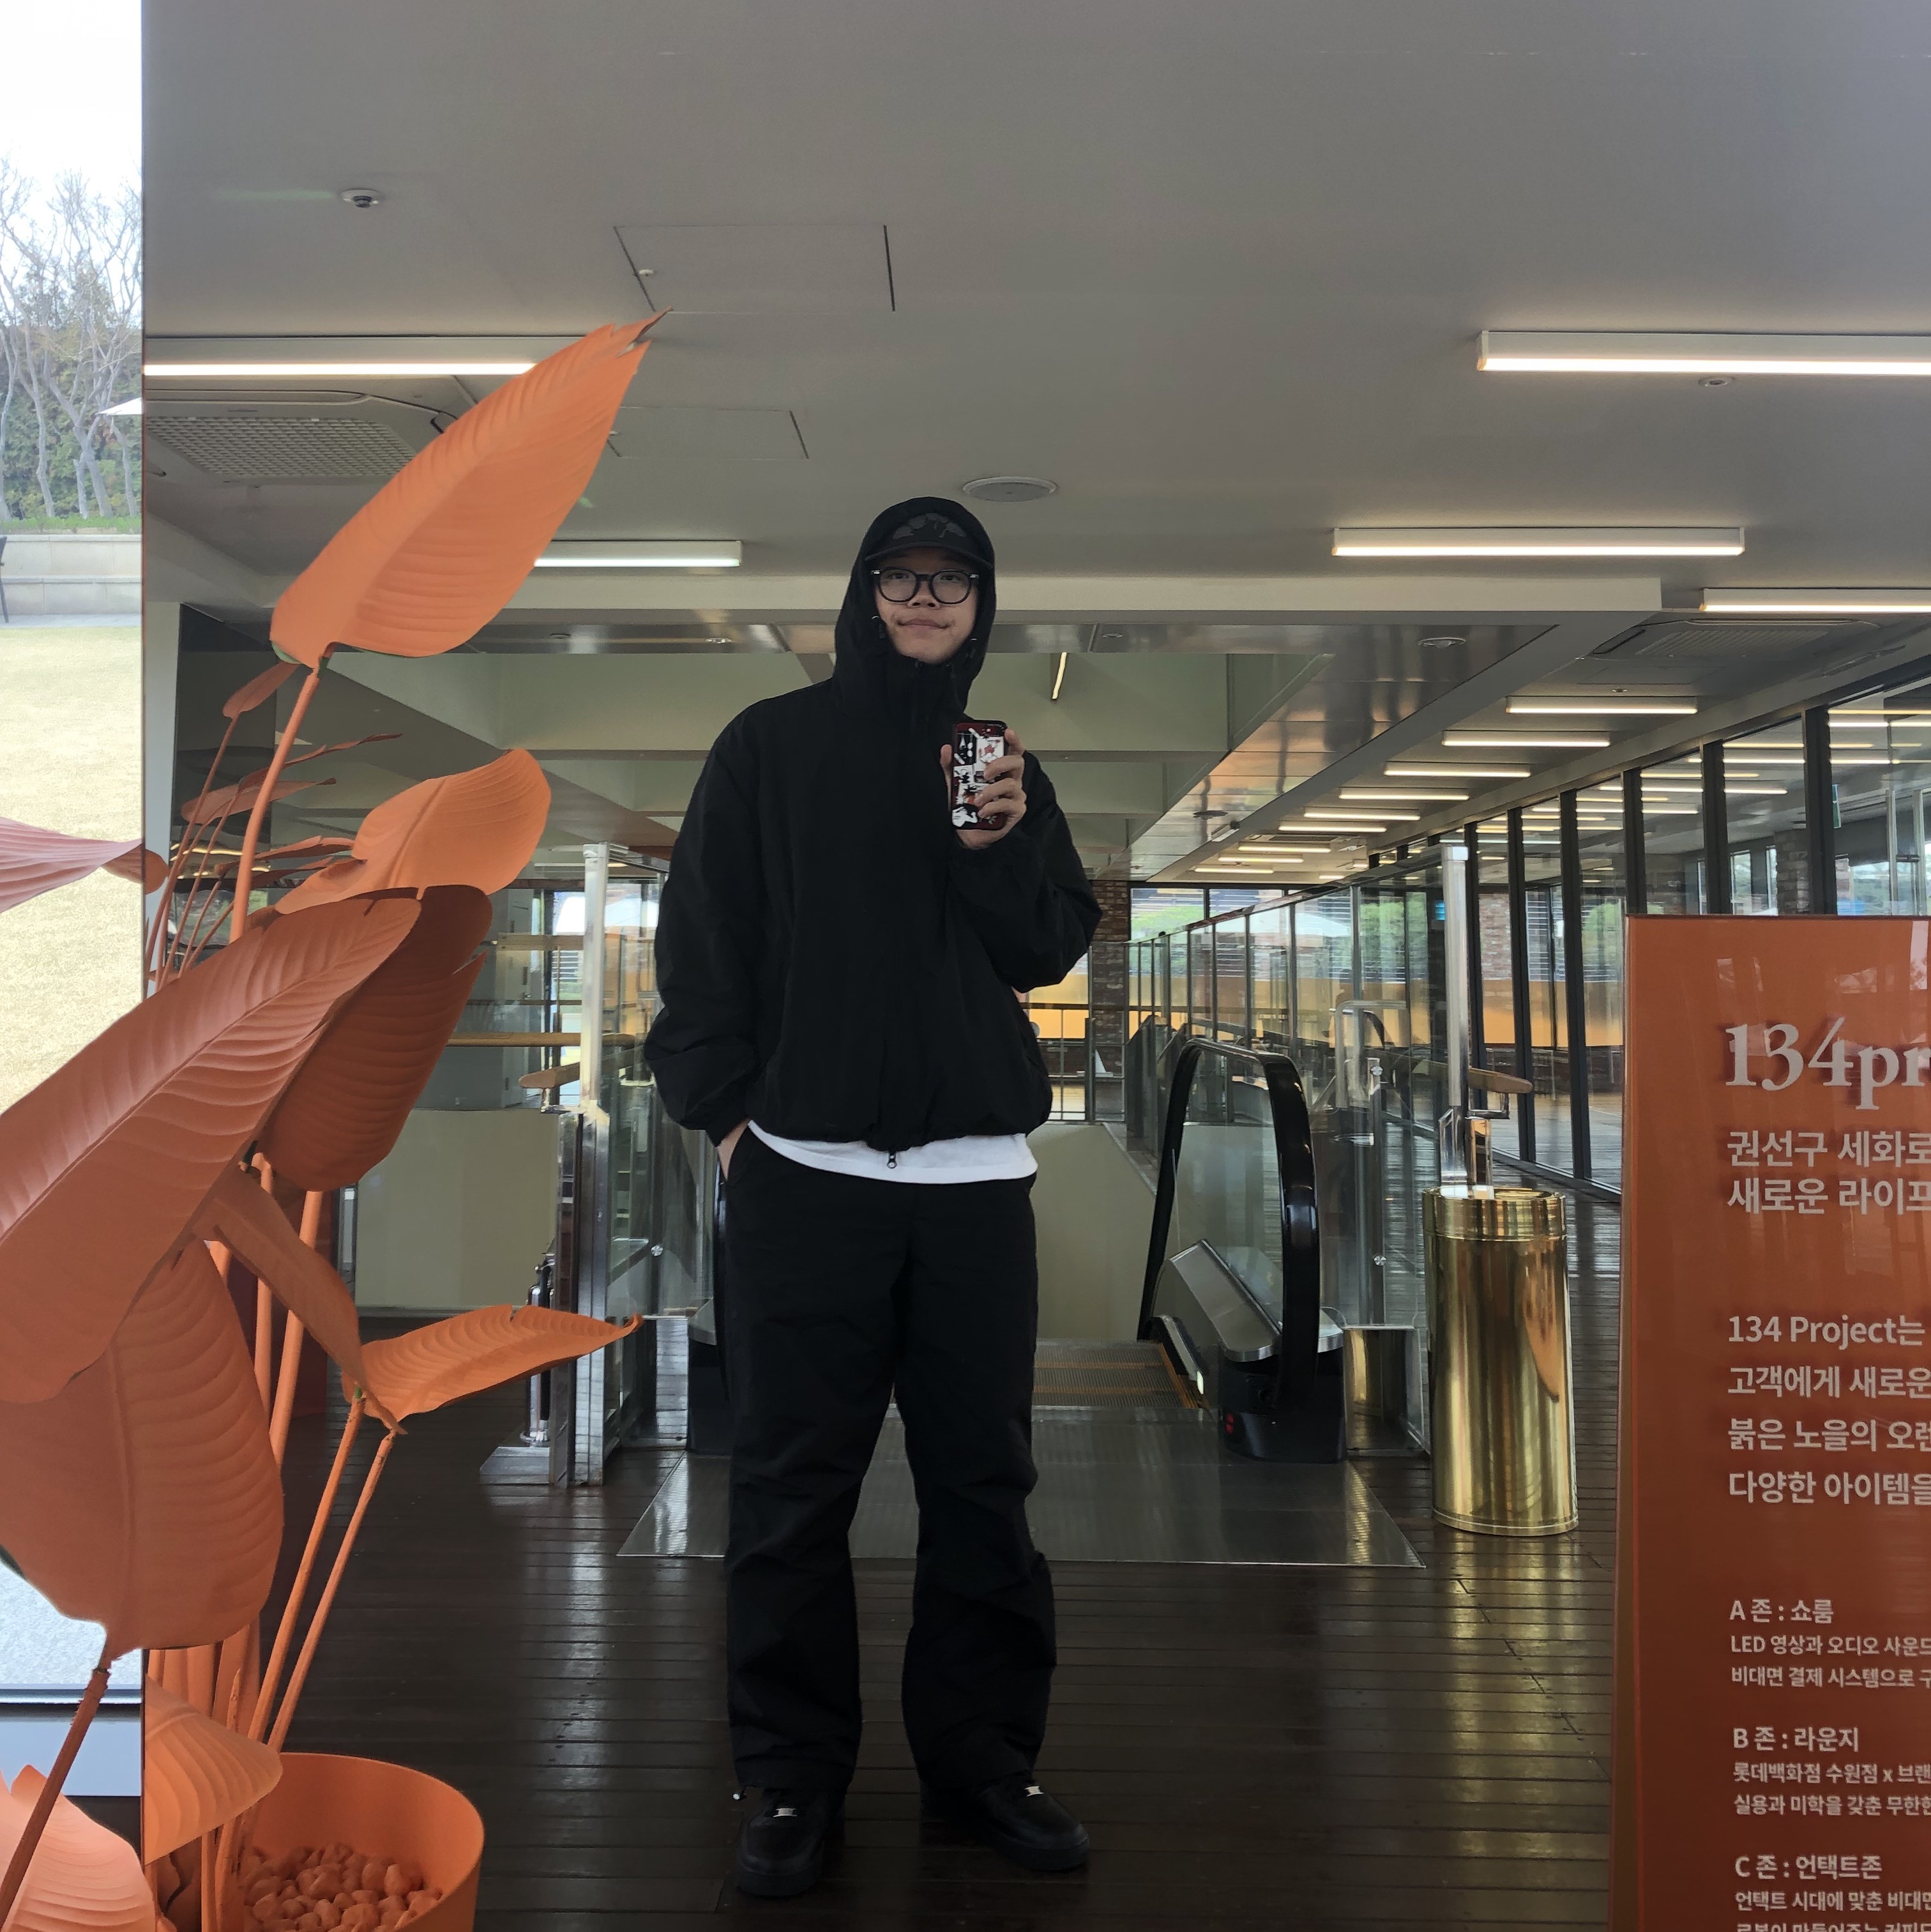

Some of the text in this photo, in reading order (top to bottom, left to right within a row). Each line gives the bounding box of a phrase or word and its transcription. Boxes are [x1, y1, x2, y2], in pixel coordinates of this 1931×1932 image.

[1725, 1017, 1931, 1110] 134pr
[1727, 1130, 1828, 1168] 권선구
[1727, 1177, 1828, 1215] 새로운
[1729, 1314, 1925, 1350] 134 Project는
[1727, 1365, 1931, 1399] 고객에게 새로운
[1728, 1418, 1786, 1450] 붉은
[1793, 1419, 1877, 1452] 노을의
[1729, 1470, 1817, 1503] 다양한
[1729, 1600, 1746, 1620] A
[1750, 1599, 1773, 1623] 존
[1791, 1599, 1834, 1624] 쇼룸
[1731, 1635, 1766, 1653] LED
[1770, 1634, 1824, 1655] 영상과
[1827, 1636, 1880, 1656] 오디오
[1731, 1666, 1783, 1687] 비대면
[1789, 1666, 1823, 1687] 결제
[1828, 1667, 1916, 1688] 시스템으로
[1733, 1728, 1748, 1749] B
[1754, 1726, 1776, 1751] 존
[1794, 1726, 1858, 1753] 라운지
[1733, 1762, 1821, 1784] 롯데백화점
[1826, 1763, 1878, 1784] 수원점
[1734, 1794, 1786, 1815] 실용과
[1791, 1795, 1842, 1816] 미학을
[1847, 1795, 1882, 1816] 갖춘
[1735, 1856, 1750, 1878] C
[1755, 1855, 1778, 1880] 존
[1796, 1855, 1882, 1880] 언택트존
[1735, 1890, 1787, 1912] 언택트
[1792, 1890, 1844, 1912] 시대에
[1848, 1891, 1883, 1912] 맞춘
